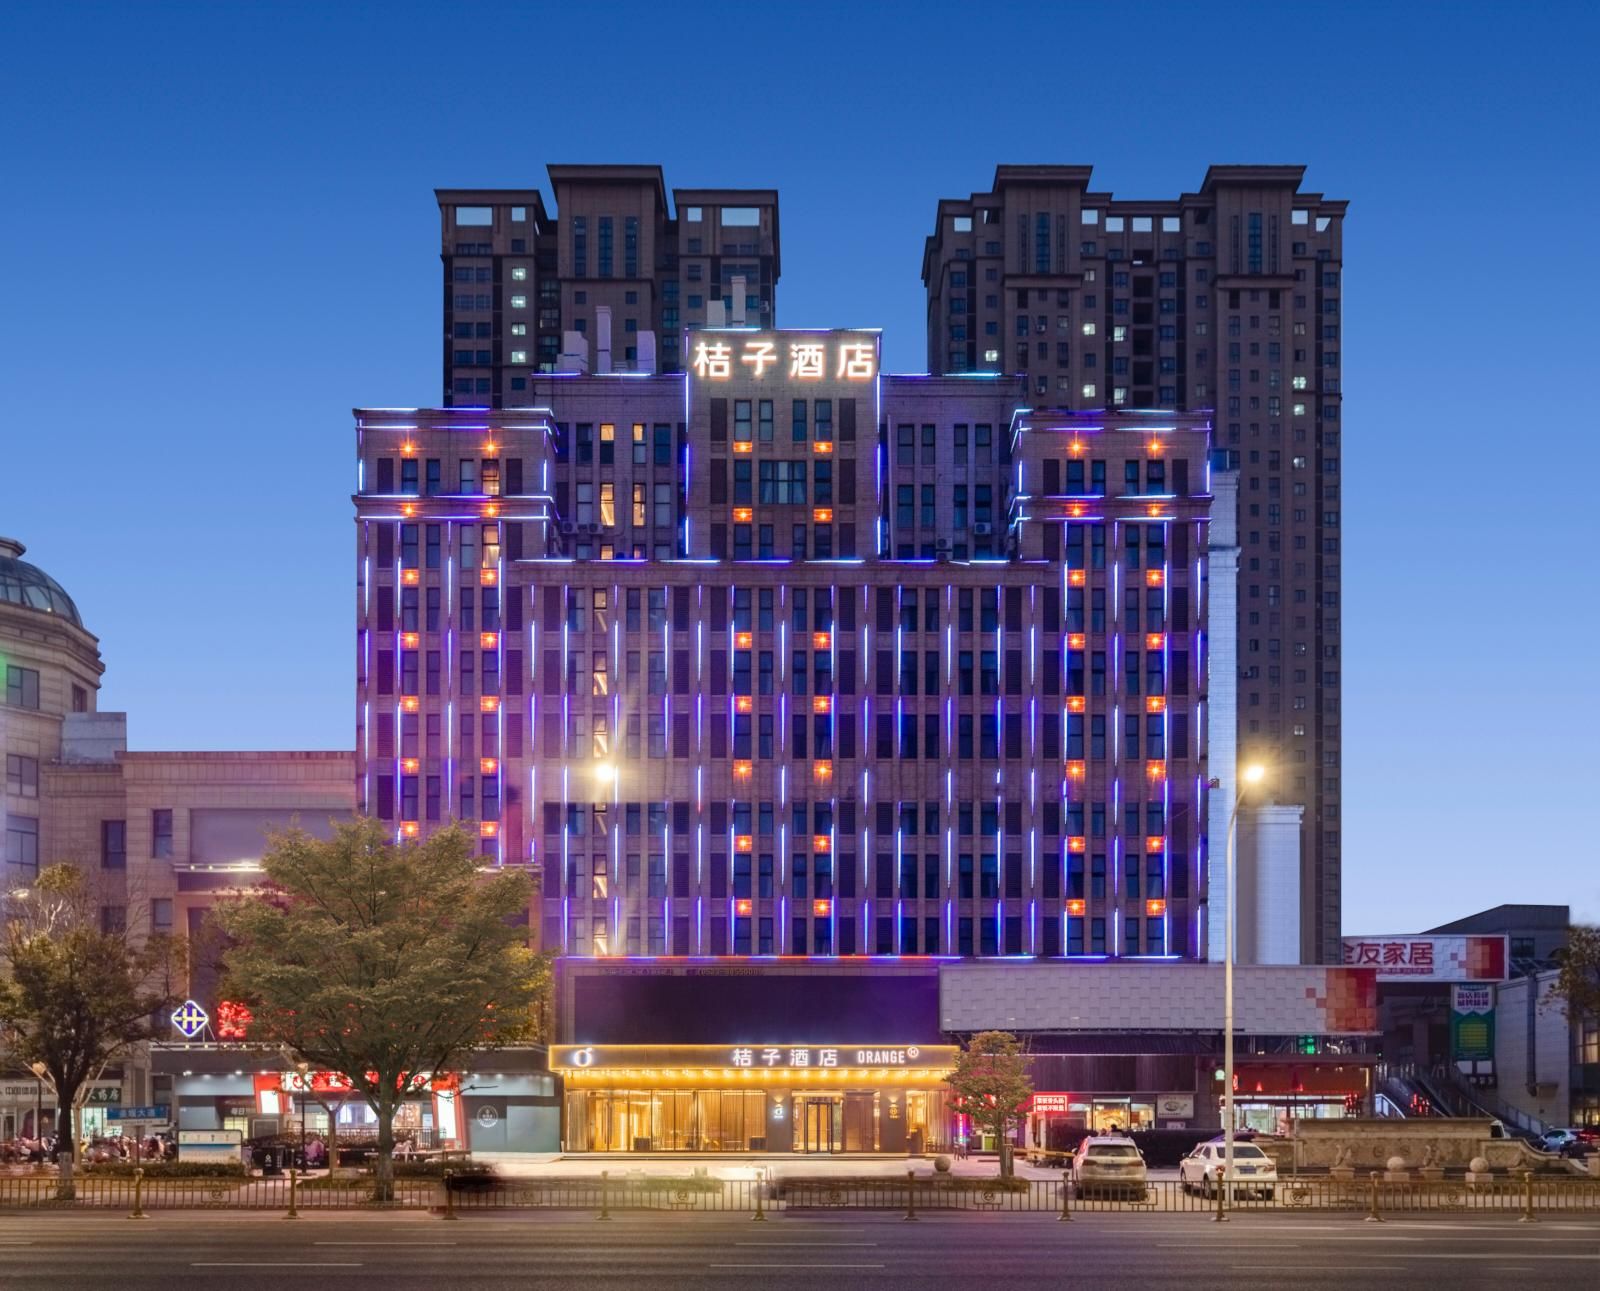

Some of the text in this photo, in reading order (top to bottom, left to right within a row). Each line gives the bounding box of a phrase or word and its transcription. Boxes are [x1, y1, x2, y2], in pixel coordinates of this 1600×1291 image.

[694, 342, 874, 377] 桔子酒店
[733, 1048, 838, 1066] 桔子酒店
[858, 1050, 905, 1064] ORANGE
